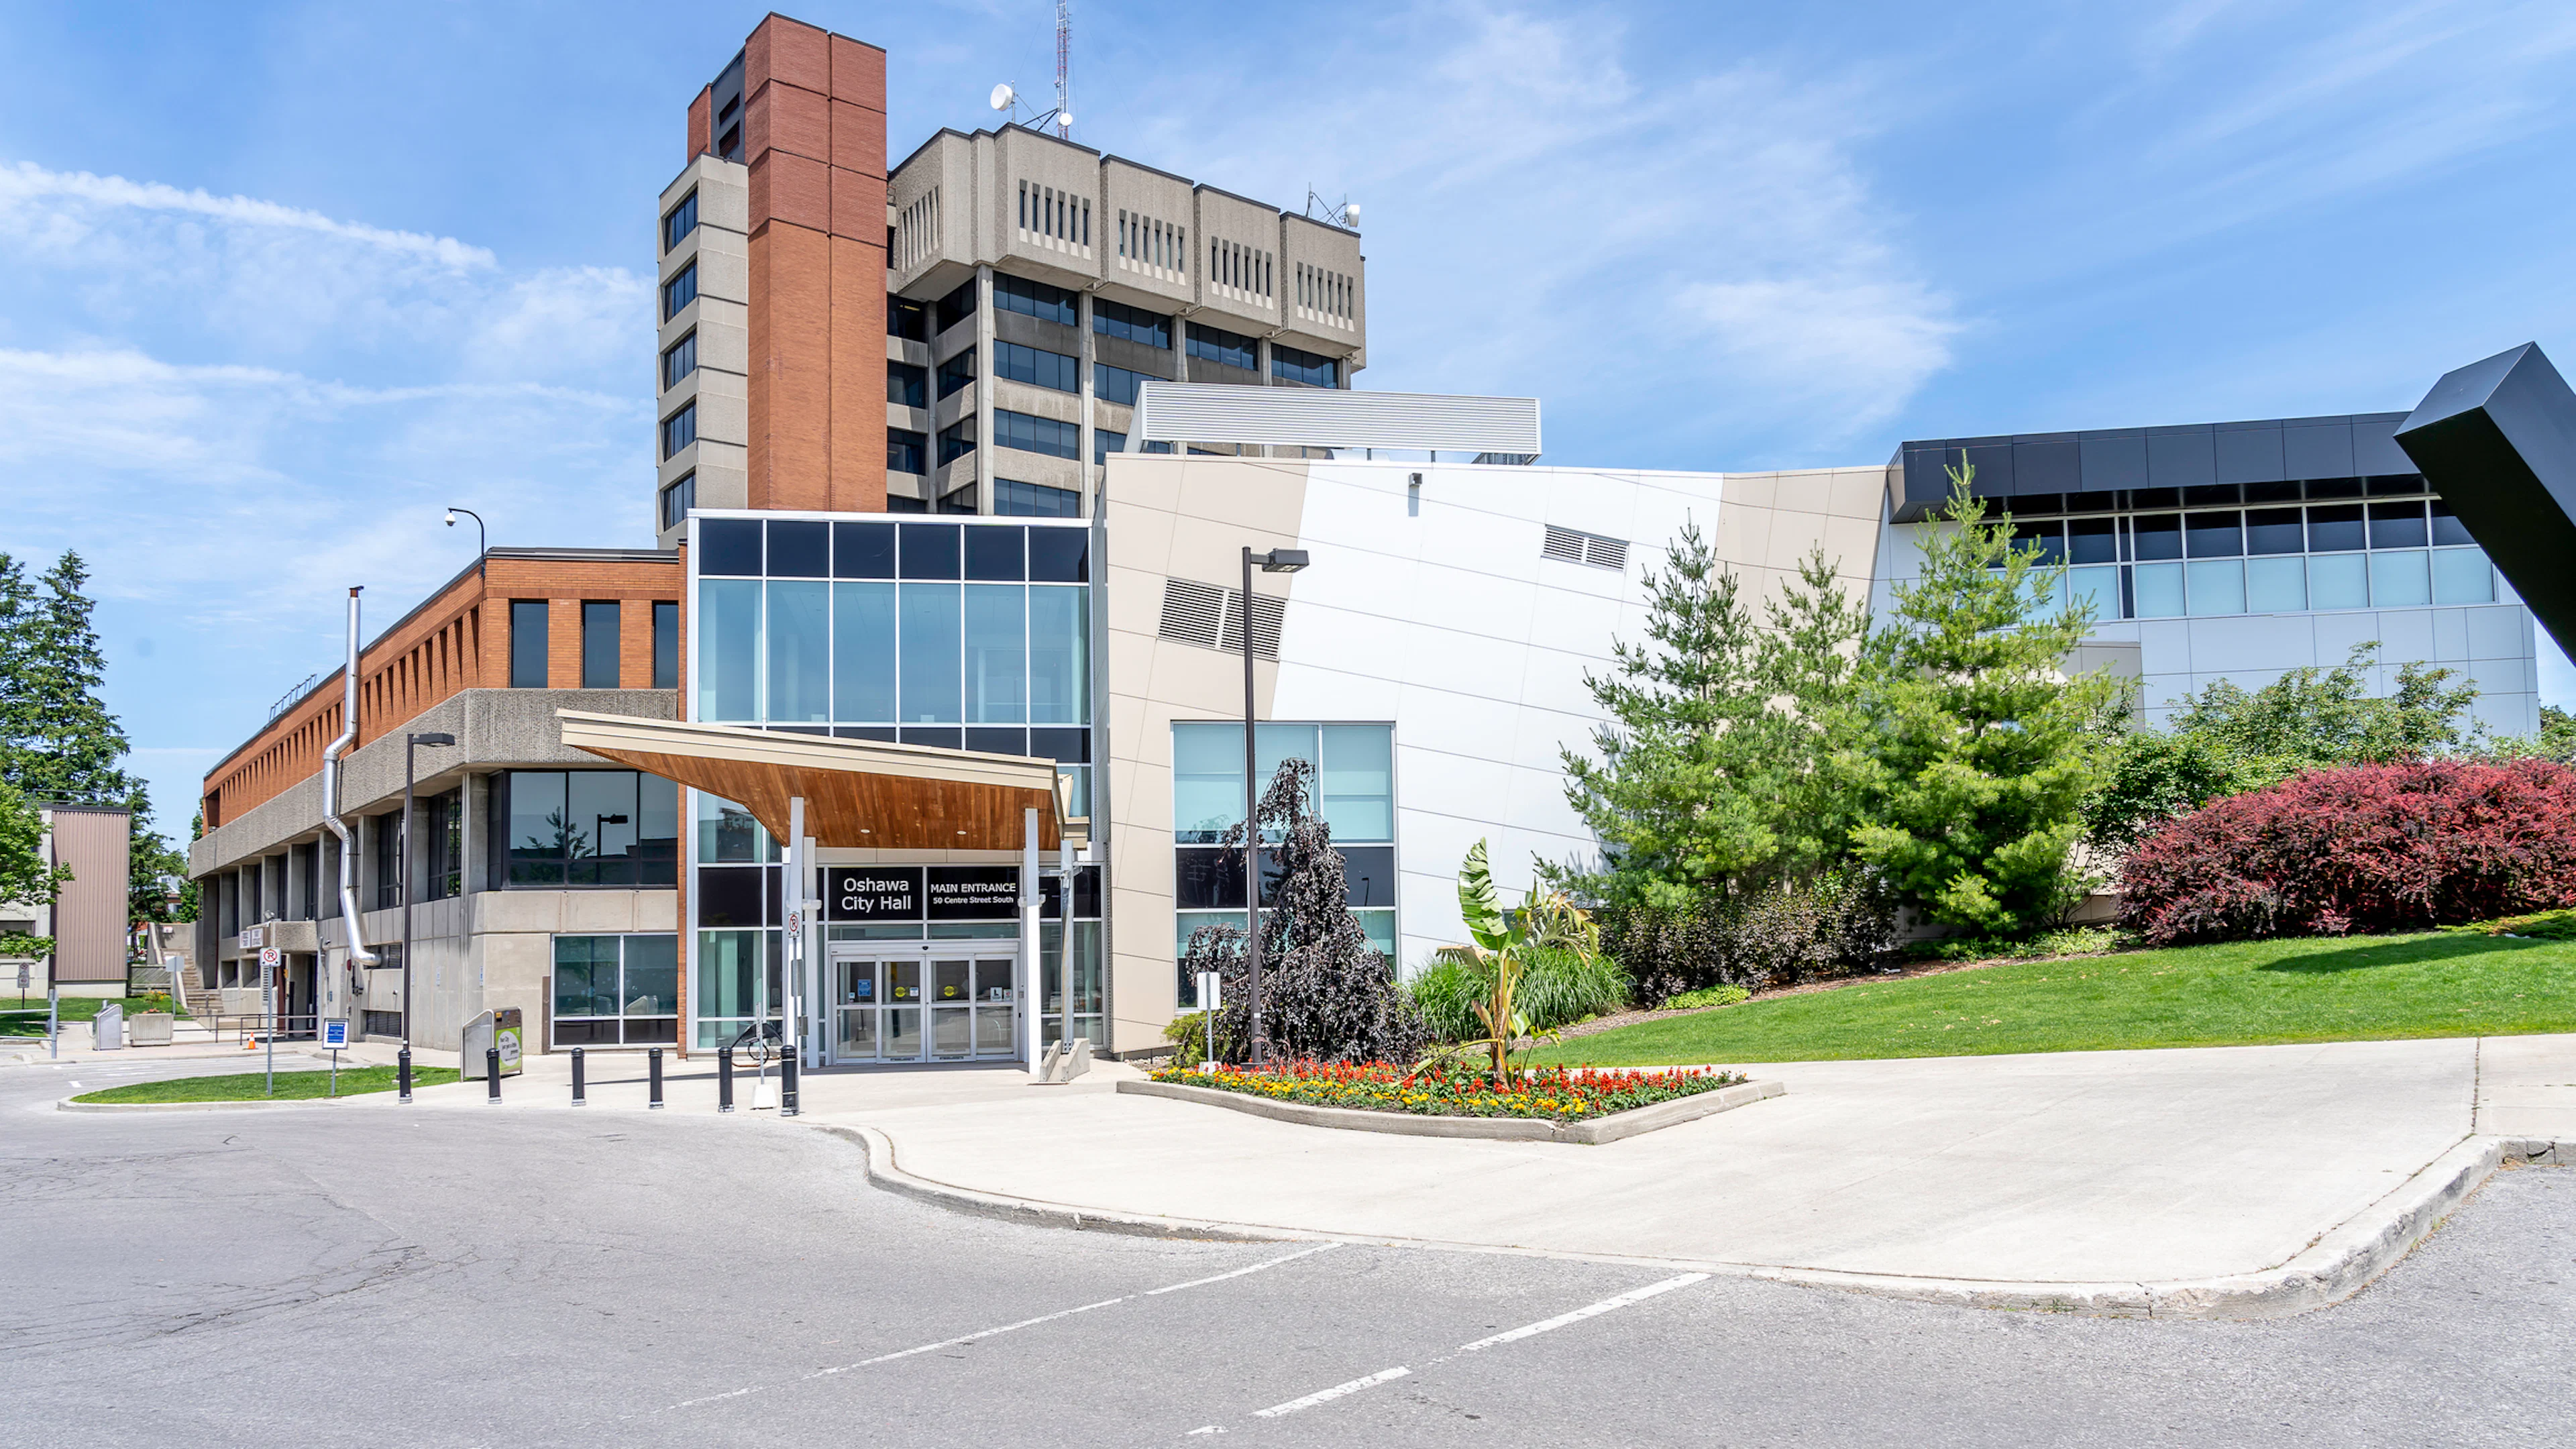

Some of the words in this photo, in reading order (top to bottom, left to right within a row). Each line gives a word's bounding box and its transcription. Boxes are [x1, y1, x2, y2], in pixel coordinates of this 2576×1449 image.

[843, 877, 909, 892] Oshawa
[930, 883, 958, 893] MAIN
[961, 882, 1016, 893] ENTRANCE
[841, 896, 875, 913] City
[880, 895, 912, 910] Hall
[933, 896, 943, 904] 50
[944, 896, 968, 904] Centre
[969, 896, 991, 904] Street
[992, 896, 1014, 904] South
